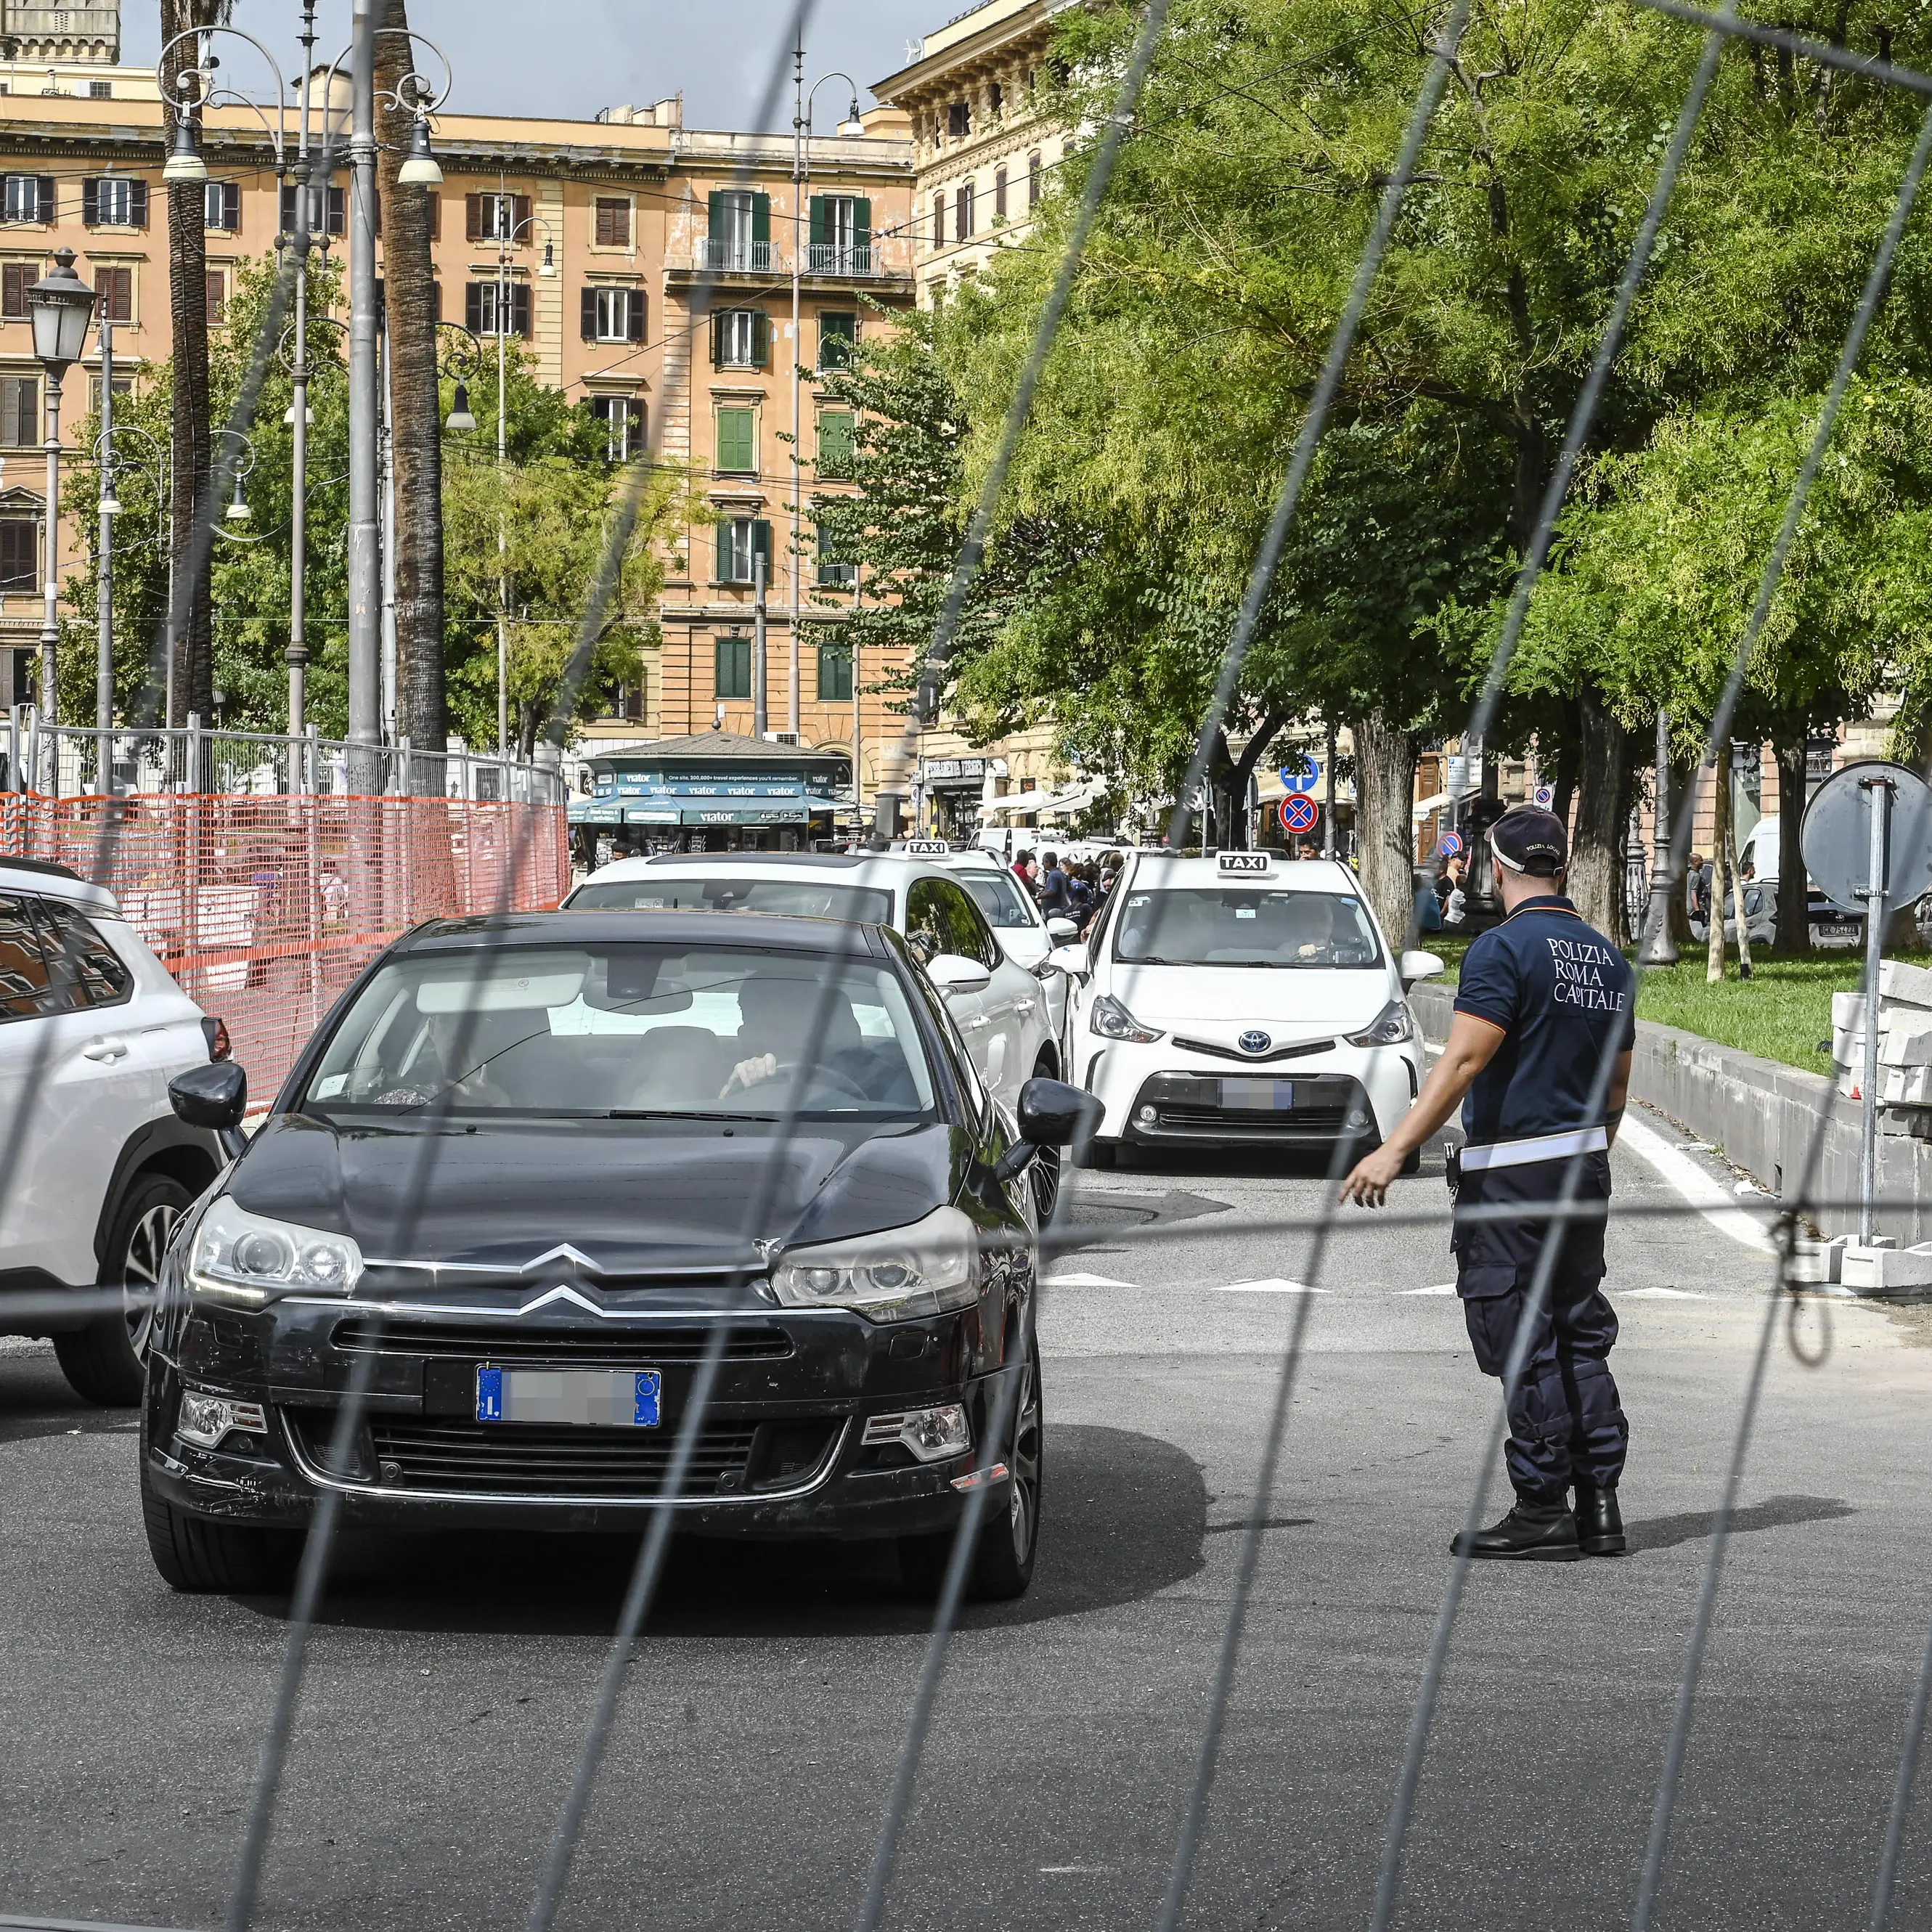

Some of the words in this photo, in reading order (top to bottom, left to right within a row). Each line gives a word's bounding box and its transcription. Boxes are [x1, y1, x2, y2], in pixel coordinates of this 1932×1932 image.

[627, 774, 651, 783] viator
[812, 775, 828, 783] viator
[617, 786, 641, 795] viator
[650, 786, 677, 795] viator
[689, 786, 717, 795] viator
[727, 786, 756, 795] viator
[767, 787, 795, 796] viator
[805, 787, 822, 796] viator
[700, 812, 734, 822] viator
[910, 843, 944, 852] TAXI
[1221, 857, 1264, 869] TAXI
[1546, 938, 1615, 966] POLIZIA
[1554, 959, 1605, 987] ROMA
[1554, 982, 1626, 1011] CAPITALE
